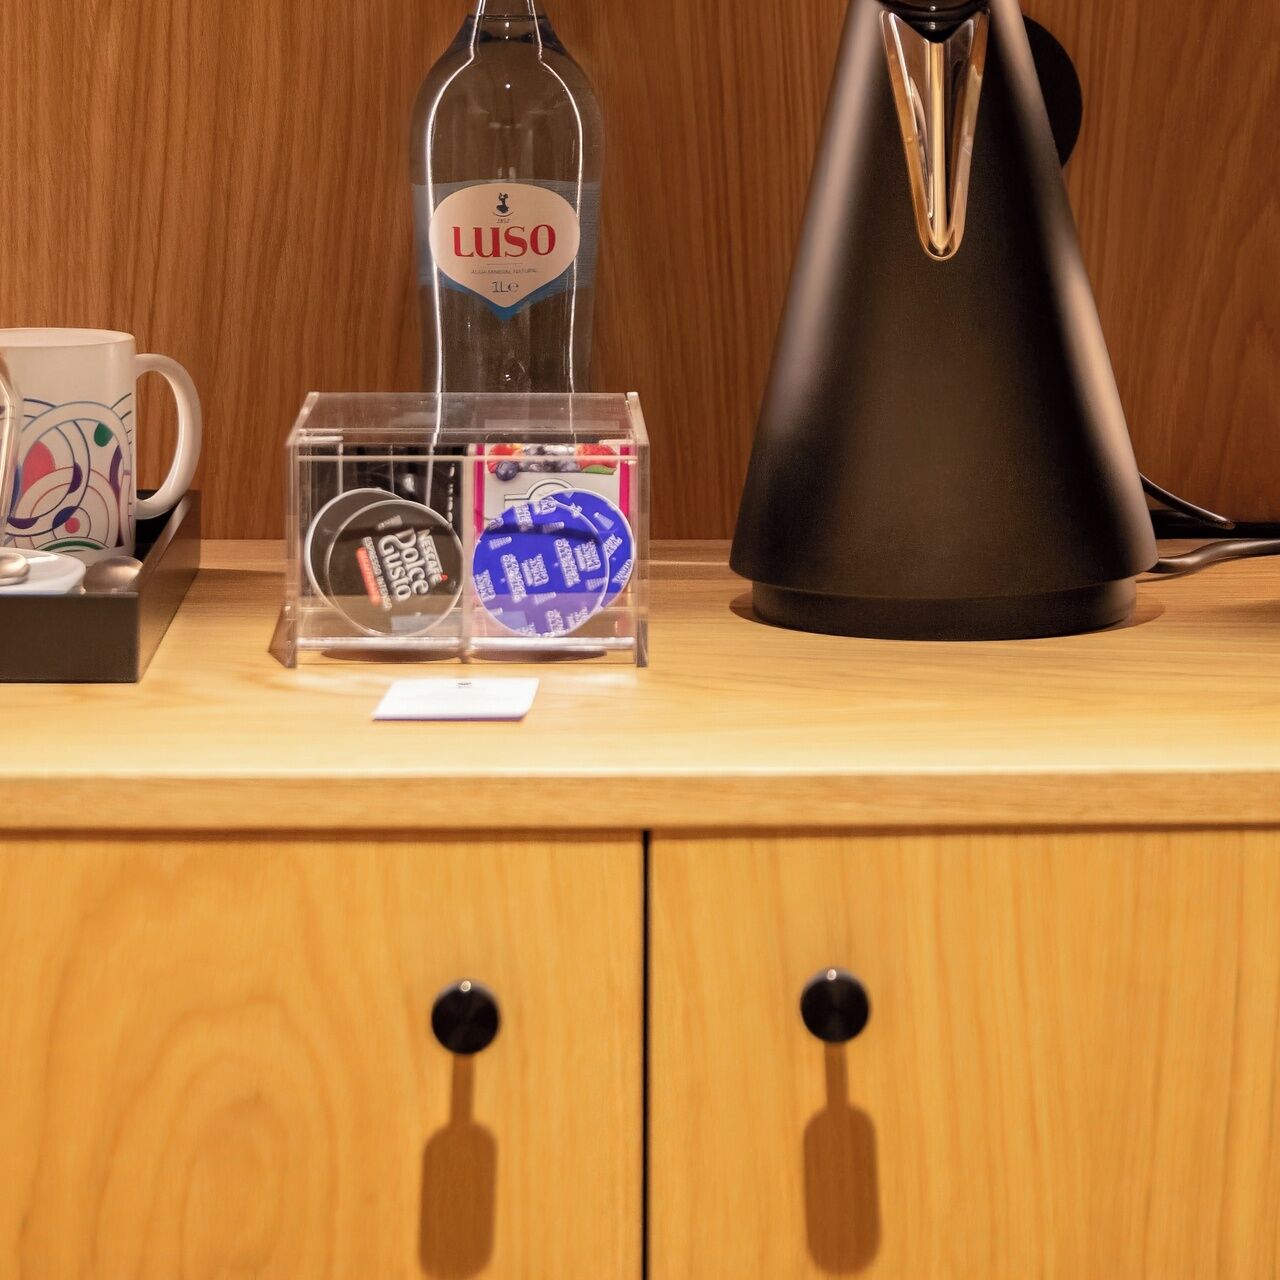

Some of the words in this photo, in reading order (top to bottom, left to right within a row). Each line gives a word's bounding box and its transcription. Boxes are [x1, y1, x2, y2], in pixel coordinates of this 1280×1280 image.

[452, 224, 556, 258] LUSO
[378, 535, 412, 602] Gusto
[395, 528, 429, 595] Dolce
